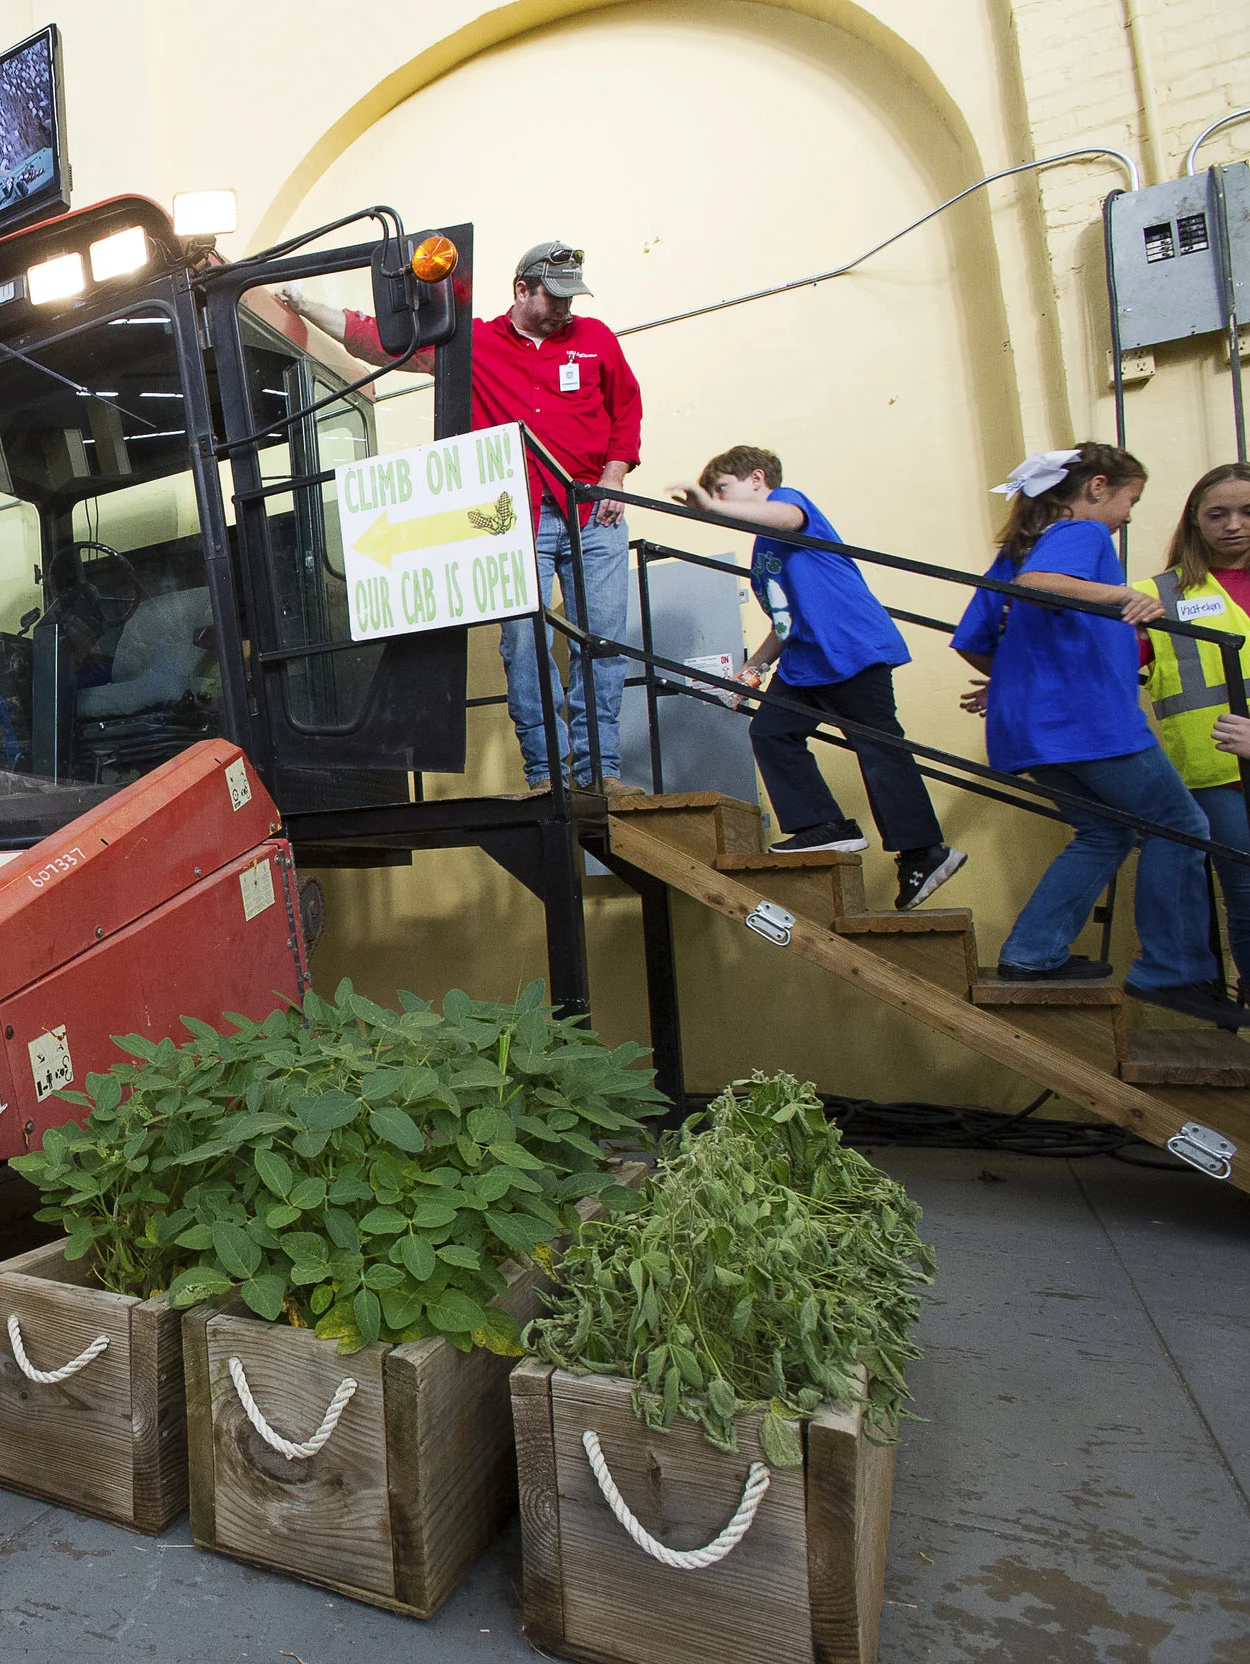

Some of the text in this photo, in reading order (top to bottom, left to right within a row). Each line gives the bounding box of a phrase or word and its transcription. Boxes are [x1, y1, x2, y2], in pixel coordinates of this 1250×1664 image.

[344, 432, 514, 514] CLIMB ON IN!
[355, 549, 528, 633] OUR CAB IS OPEN
[27, 846, 87, 888] 607337
